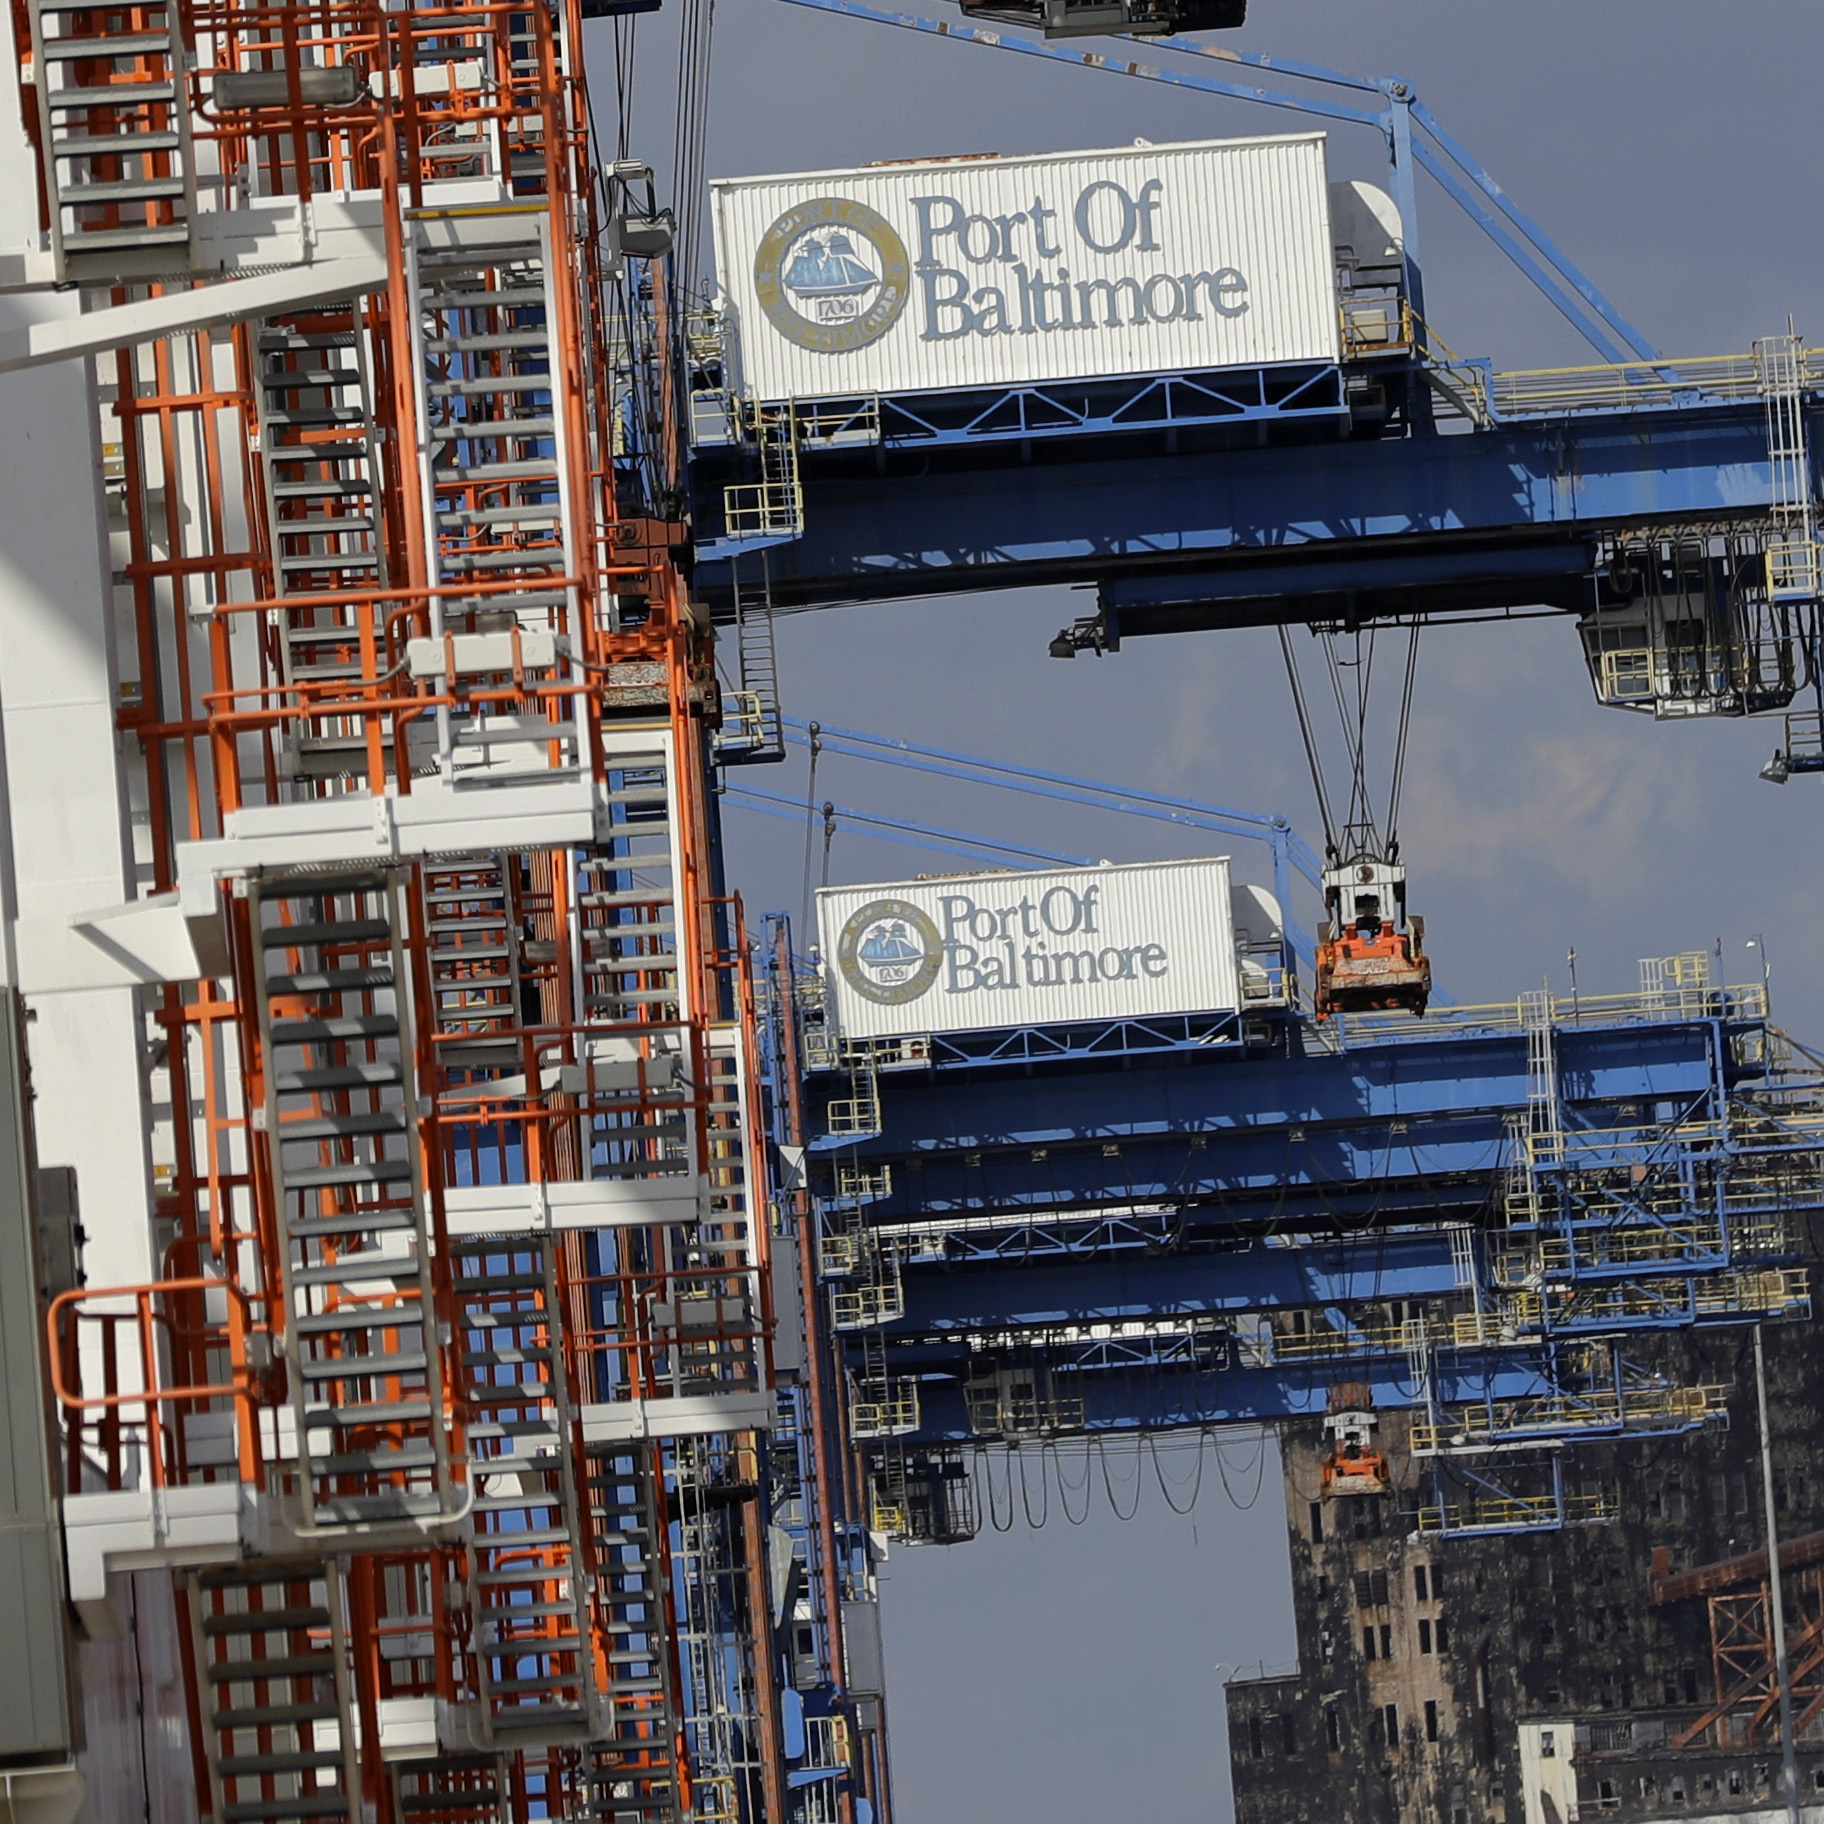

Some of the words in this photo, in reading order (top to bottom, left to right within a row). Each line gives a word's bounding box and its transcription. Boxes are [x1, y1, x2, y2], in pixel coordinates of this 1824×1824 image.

[909, 194, 1061, 267] Port
[1074, 178, 1163, 255] Of
[818, 299, 855, 317] 1706
[916, 263, 1249, 342] Baltimore
[937, 894, 1038, 945] Port
[1039, 884, 1100, 936] Of
[942, 940, 1168, 995] Baltimore
